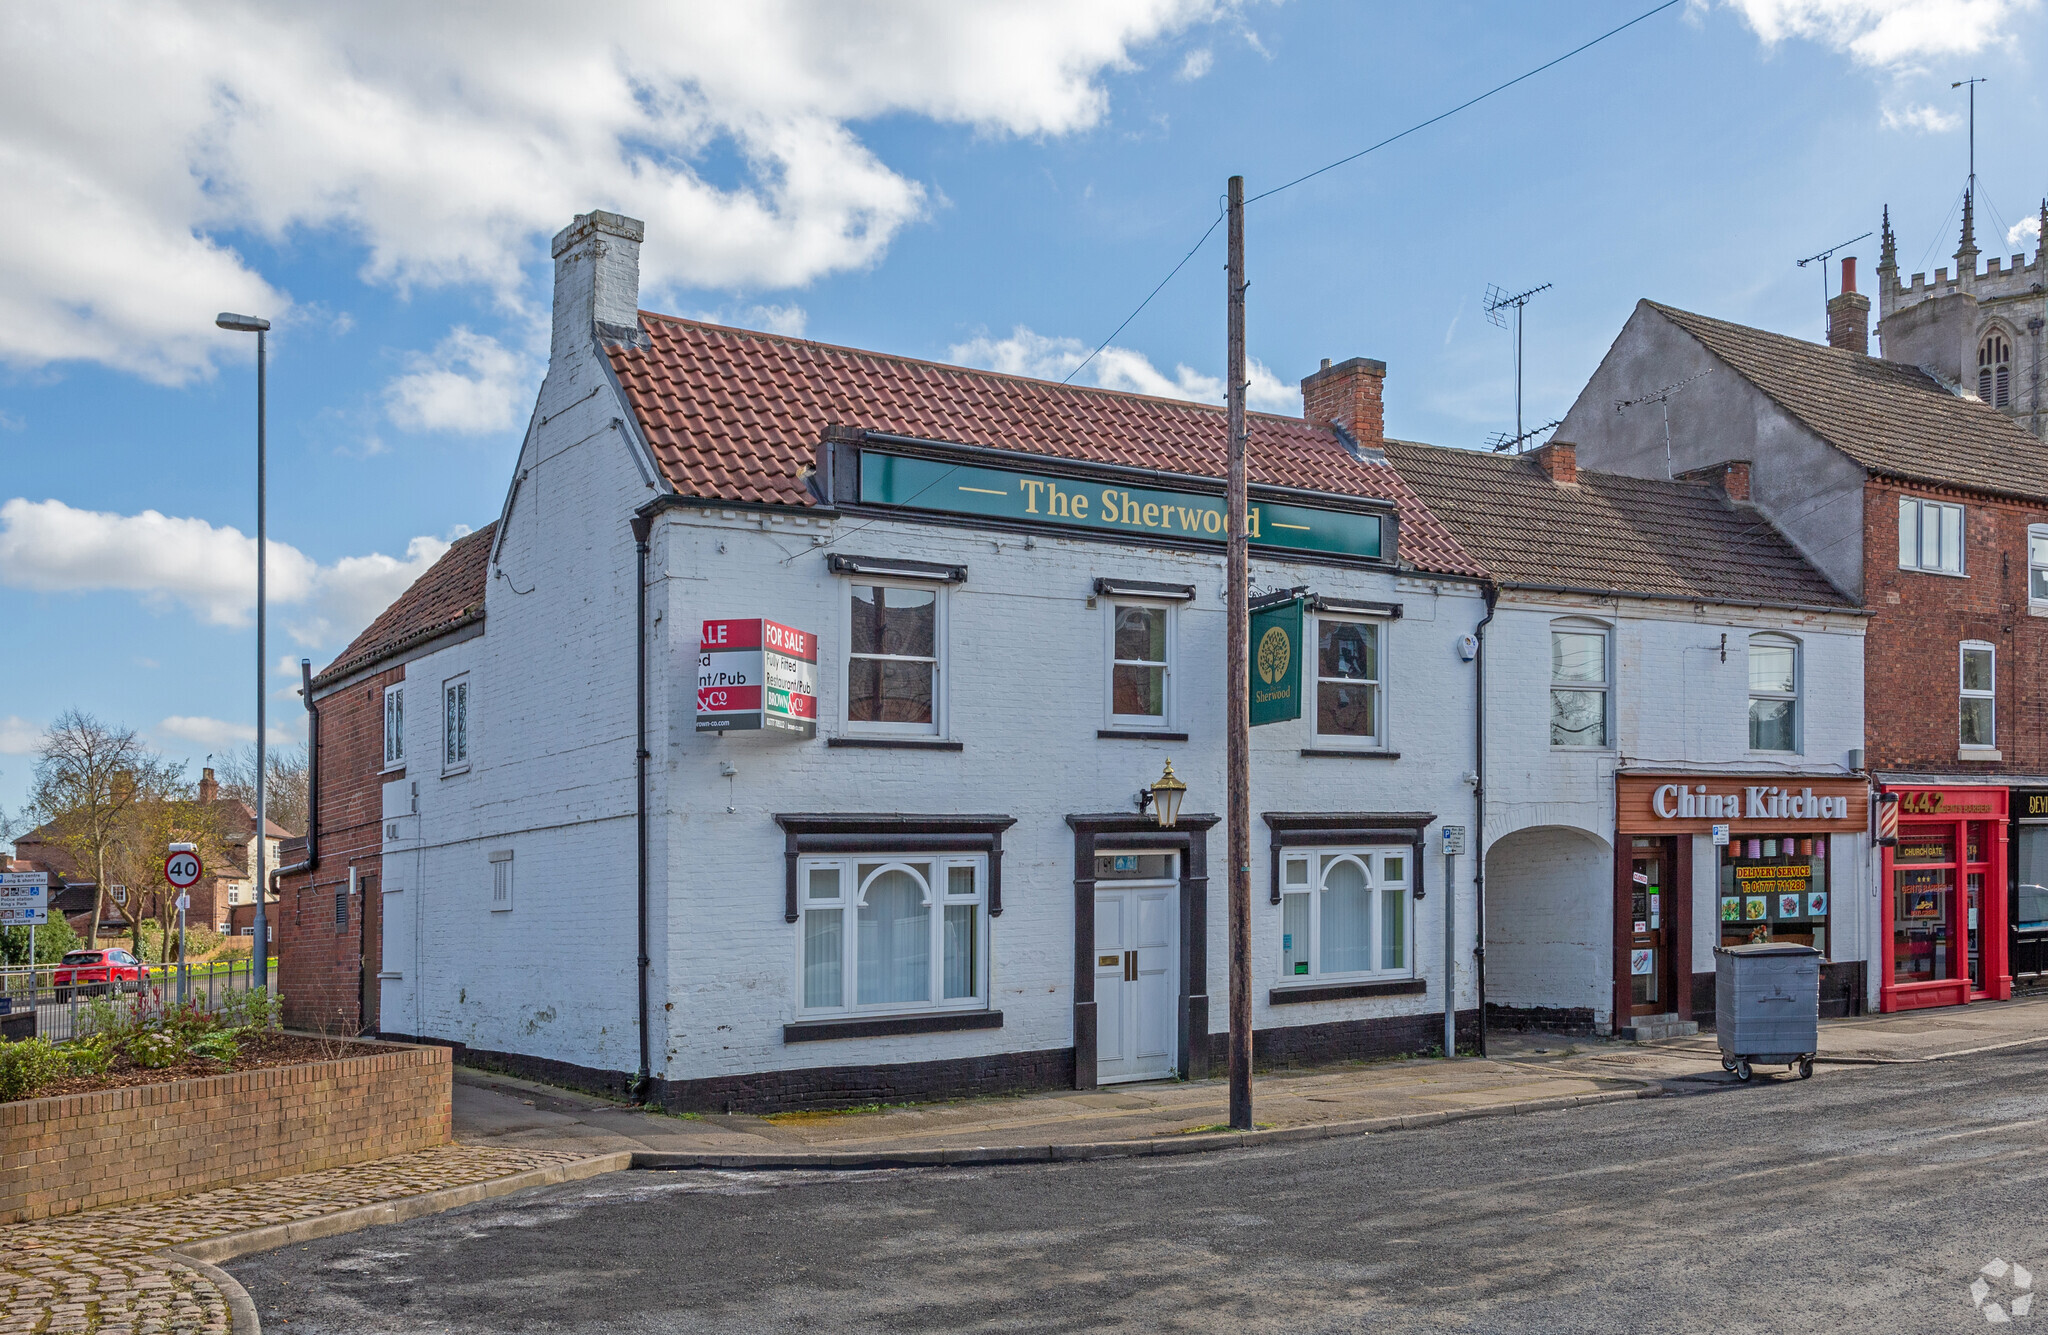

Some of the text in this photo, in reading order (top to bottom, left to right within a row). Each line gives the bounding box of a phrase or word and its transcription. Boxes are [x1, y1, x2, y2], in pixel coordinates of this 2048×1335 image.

[1020, 479, 1261, 538] The Sherwod
[766, 624, 804, 653] FOR SALE
[766, 652, 797, 673] Fully Fitted
[766, 672, 811, 694] Restaurant/Pub
[1256, 685, 1290, 703] Sherwood
[1653, 784, 1848, 819] China Kitchen
[1903, 791, 1944, 813] 4.4.2
[1904, 847, 1943, 856] CHURCH GATE
[170, 862, 197, 877] 40
[1736, 865, 1811, 879] DELIVERY SERVICE
[1751, 880, 1776, 893] 01777
[1777, 879, 1806, 892] 711288
